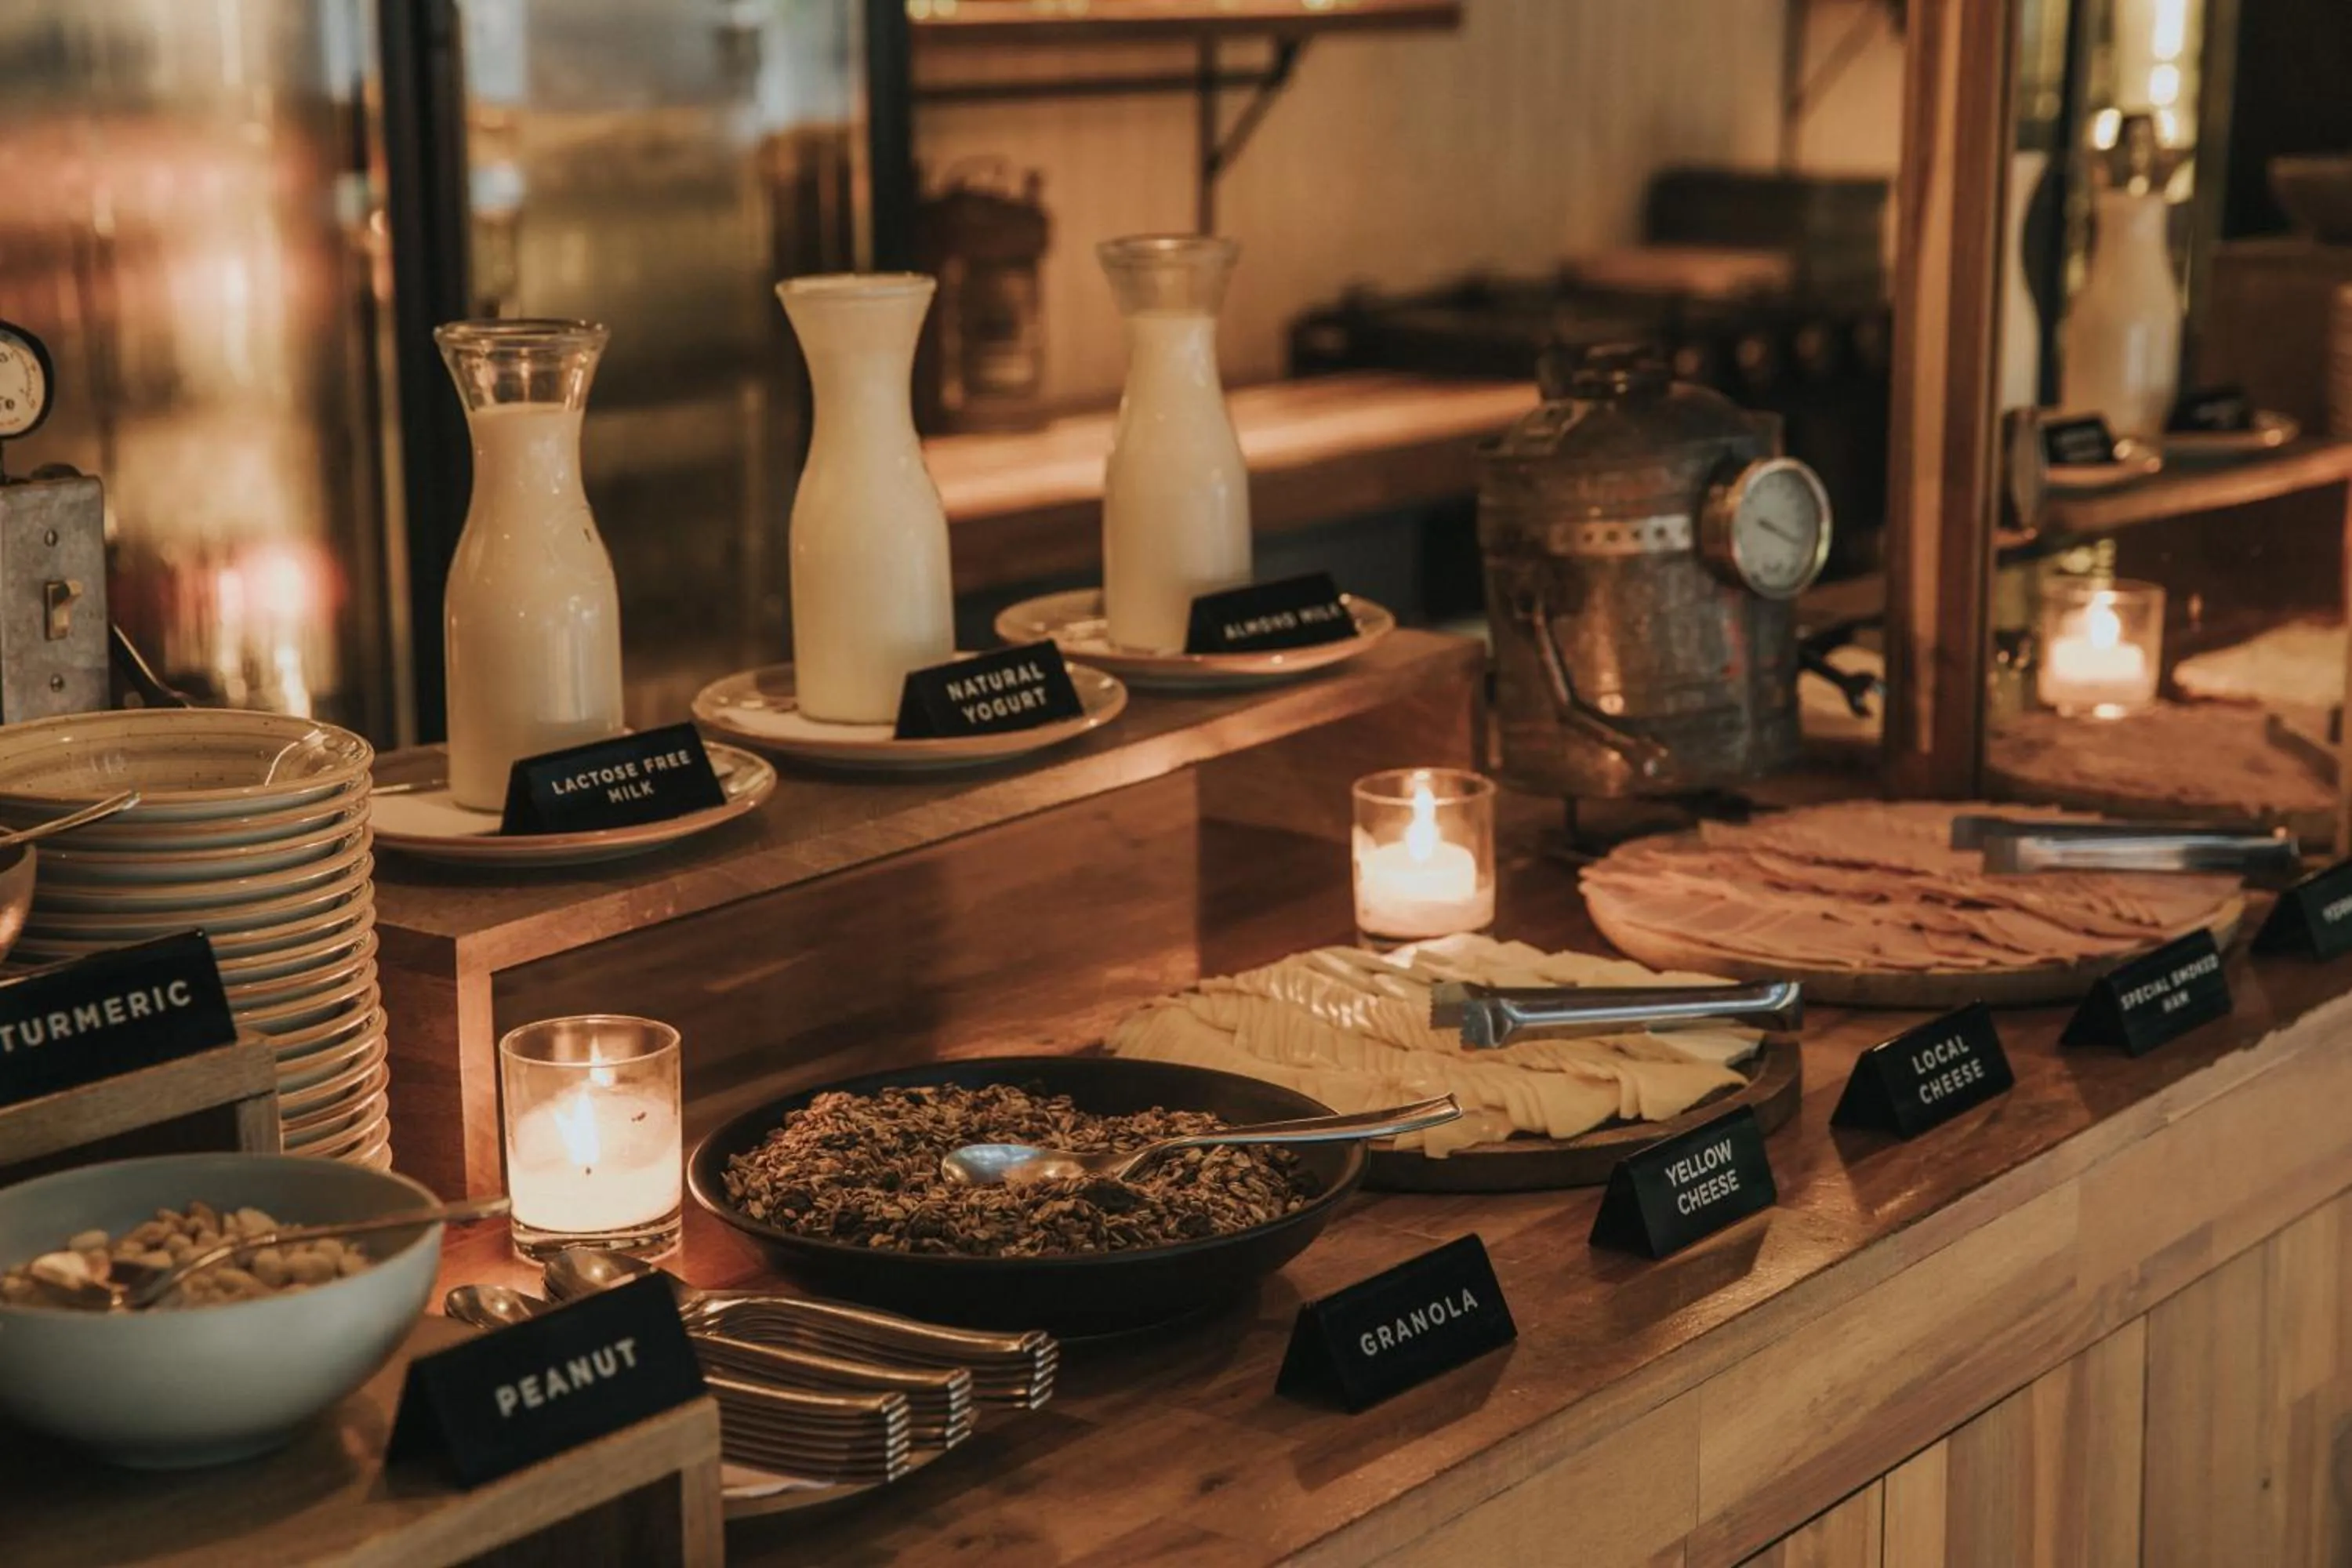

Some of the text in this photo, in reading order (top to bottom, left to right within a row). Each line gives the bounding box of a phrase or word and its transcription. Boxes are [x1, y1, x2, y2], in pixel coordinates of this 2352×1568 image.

[946, 661, 1045, 702] NATURAL
[961, 687, 1047, 724] YOGURT
[551, 750, 691, 795] LACTOSE FREE
[607, 780, 655, 804] MILK
[0, 980, 191, 1052] TURMERIC
[1911, 1034, 1969, 1075] LOCAL
[1919, 1058, 1985, 1104] CHEESE
[1664, 1138, 1732, 1188] YELLOW
[1677, 1169, 1740, 1214] CHEESE
[1359, 1287, 1479, 1356] GRANOLA
[495, 1337, 637, 1417] PEANUT
